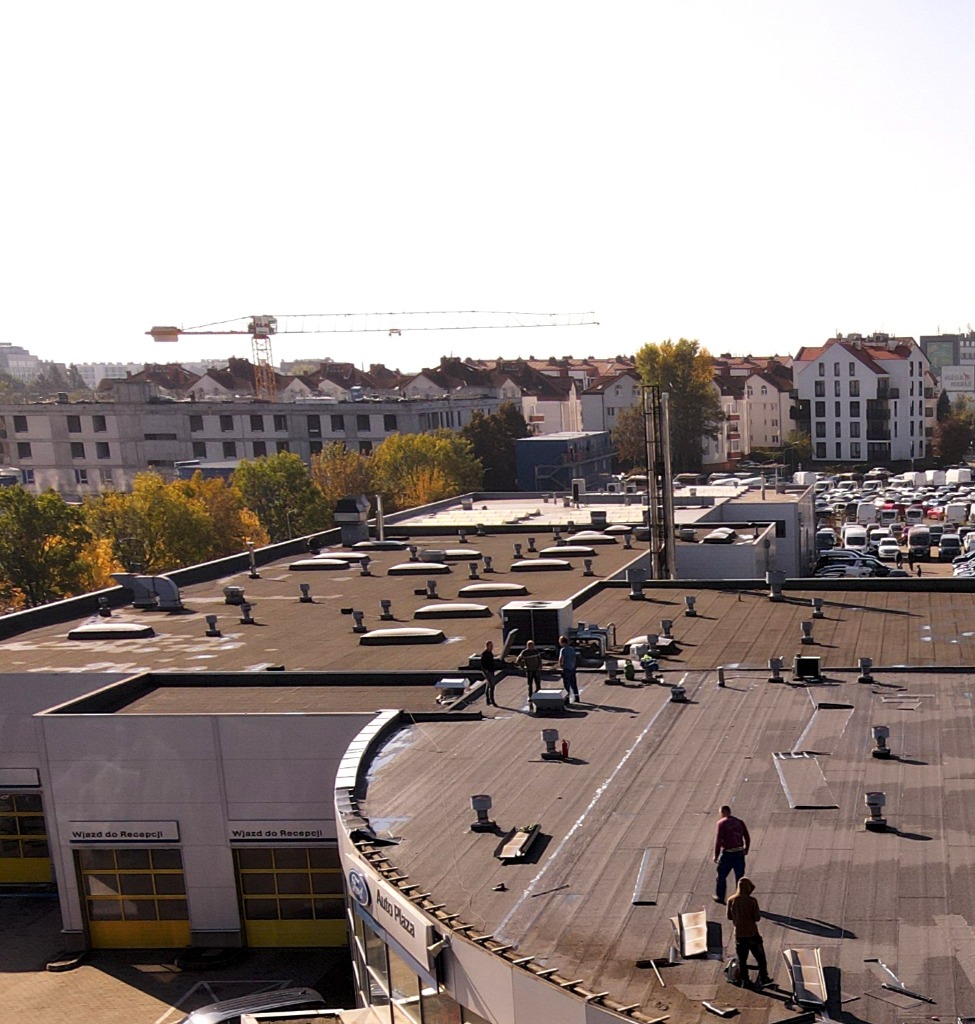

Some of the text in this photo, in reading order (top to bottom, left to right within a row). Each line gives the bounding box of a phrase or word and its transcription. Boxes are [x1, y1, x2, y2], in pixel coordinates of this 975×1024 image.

[72, 830, 163, 839] Wjazd do Recepcji
[232, 829, 322, 838] Wjazd do Recepcji
[376, 888, 415, 938] Auto Plaza
